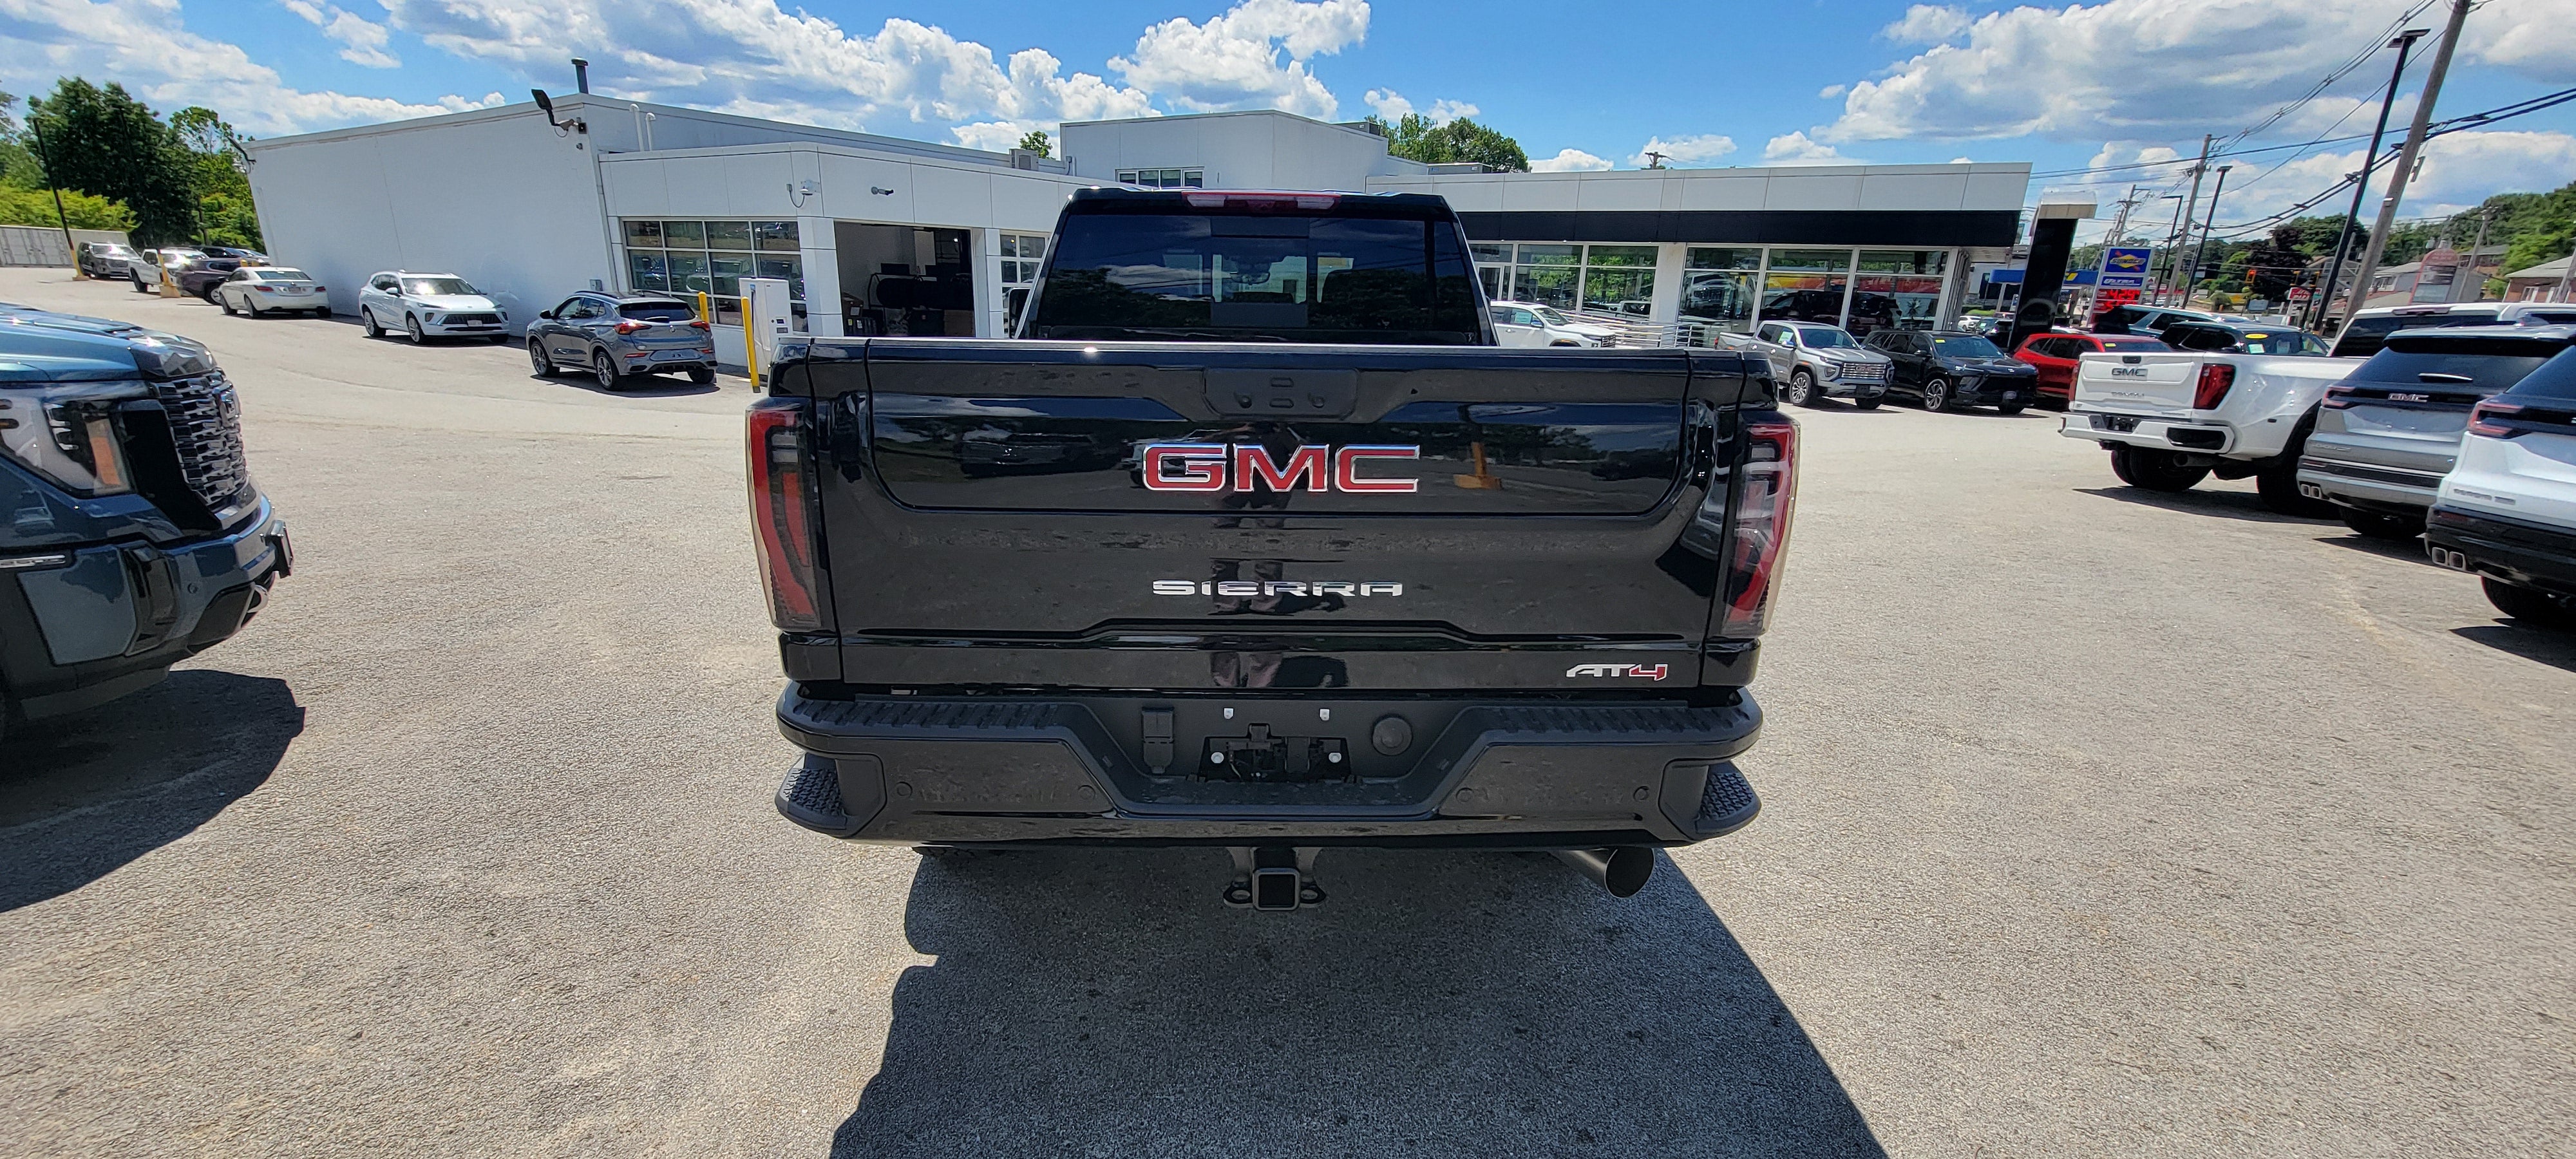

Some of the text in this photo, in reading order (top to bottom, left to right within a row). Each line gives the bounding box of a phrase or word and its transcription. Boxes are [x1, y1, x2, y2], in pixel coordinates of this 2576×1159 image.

[2112, 368, 2148, 376] GMC
[2388, 393, 2429, 402] GMC
[1143, 443, 1420, 493] GMC
[1153, 580, 1403, 597] SIERRA
[1566, 664, 1668, 681] AT4
